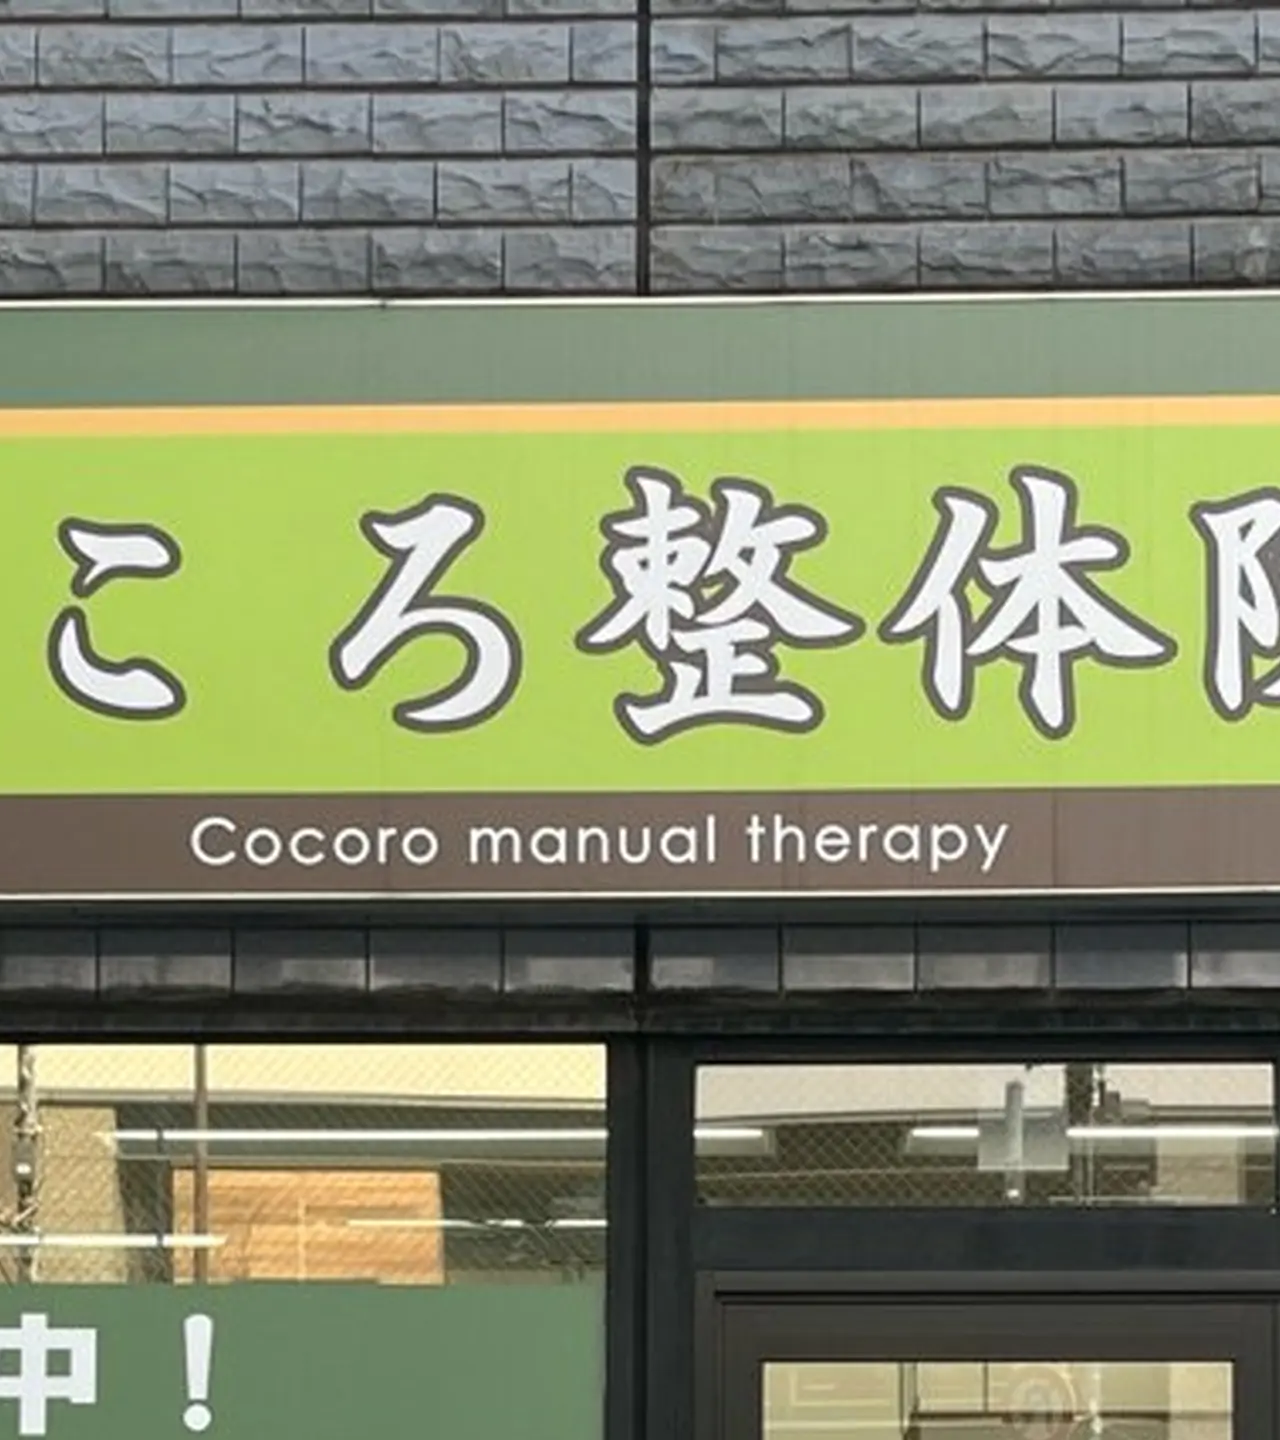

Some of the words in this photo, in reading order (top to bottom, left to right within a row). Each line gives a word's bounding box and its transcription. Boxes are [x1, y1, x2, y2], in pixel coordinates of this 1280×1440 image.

[189, 816, 440, 866] Cocoro
[467, 813, 715, 865] manual
[744, 812, 1011, 874] therapy
